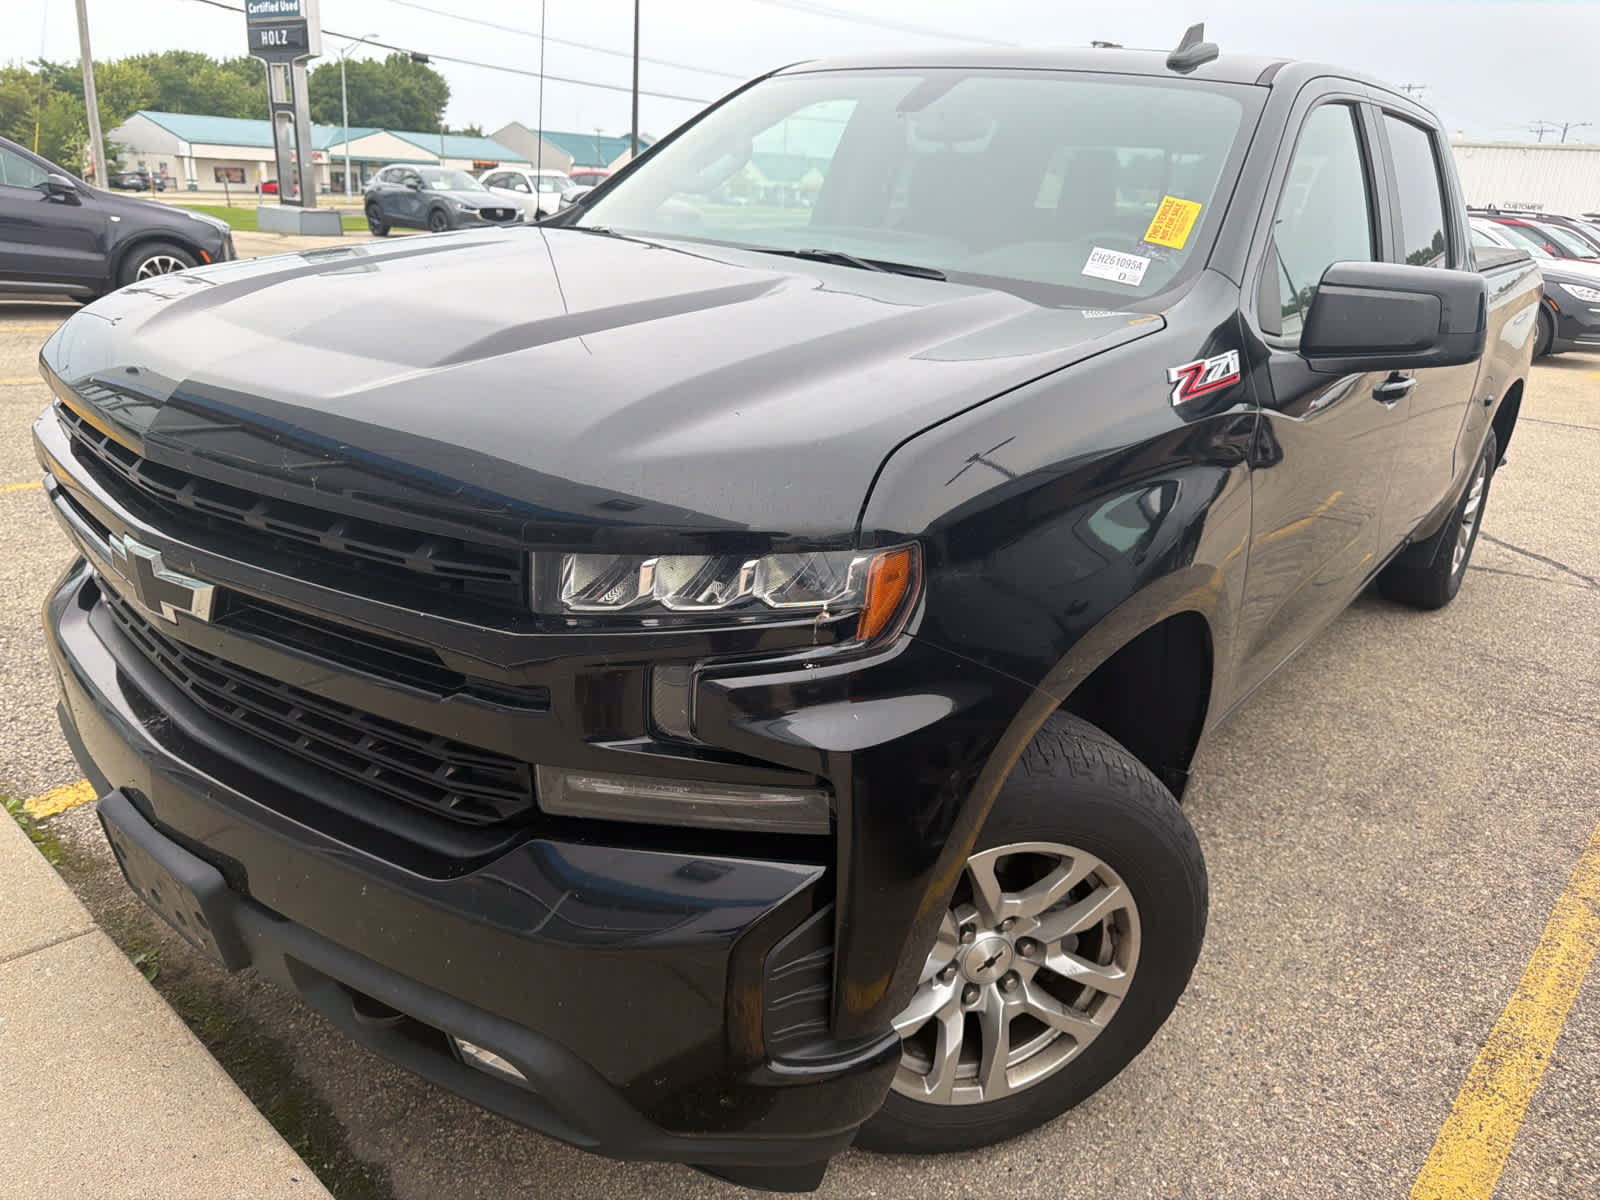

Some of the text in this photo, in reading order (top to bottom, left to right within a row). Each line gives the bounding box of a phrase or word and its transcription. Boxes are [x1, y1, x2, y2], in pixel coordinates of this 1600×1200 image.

[248, 0, 299, 14] Certified Used
[261, 30, 288, 45] HOLZ
[1167, 349, 1241, 406] Z71
